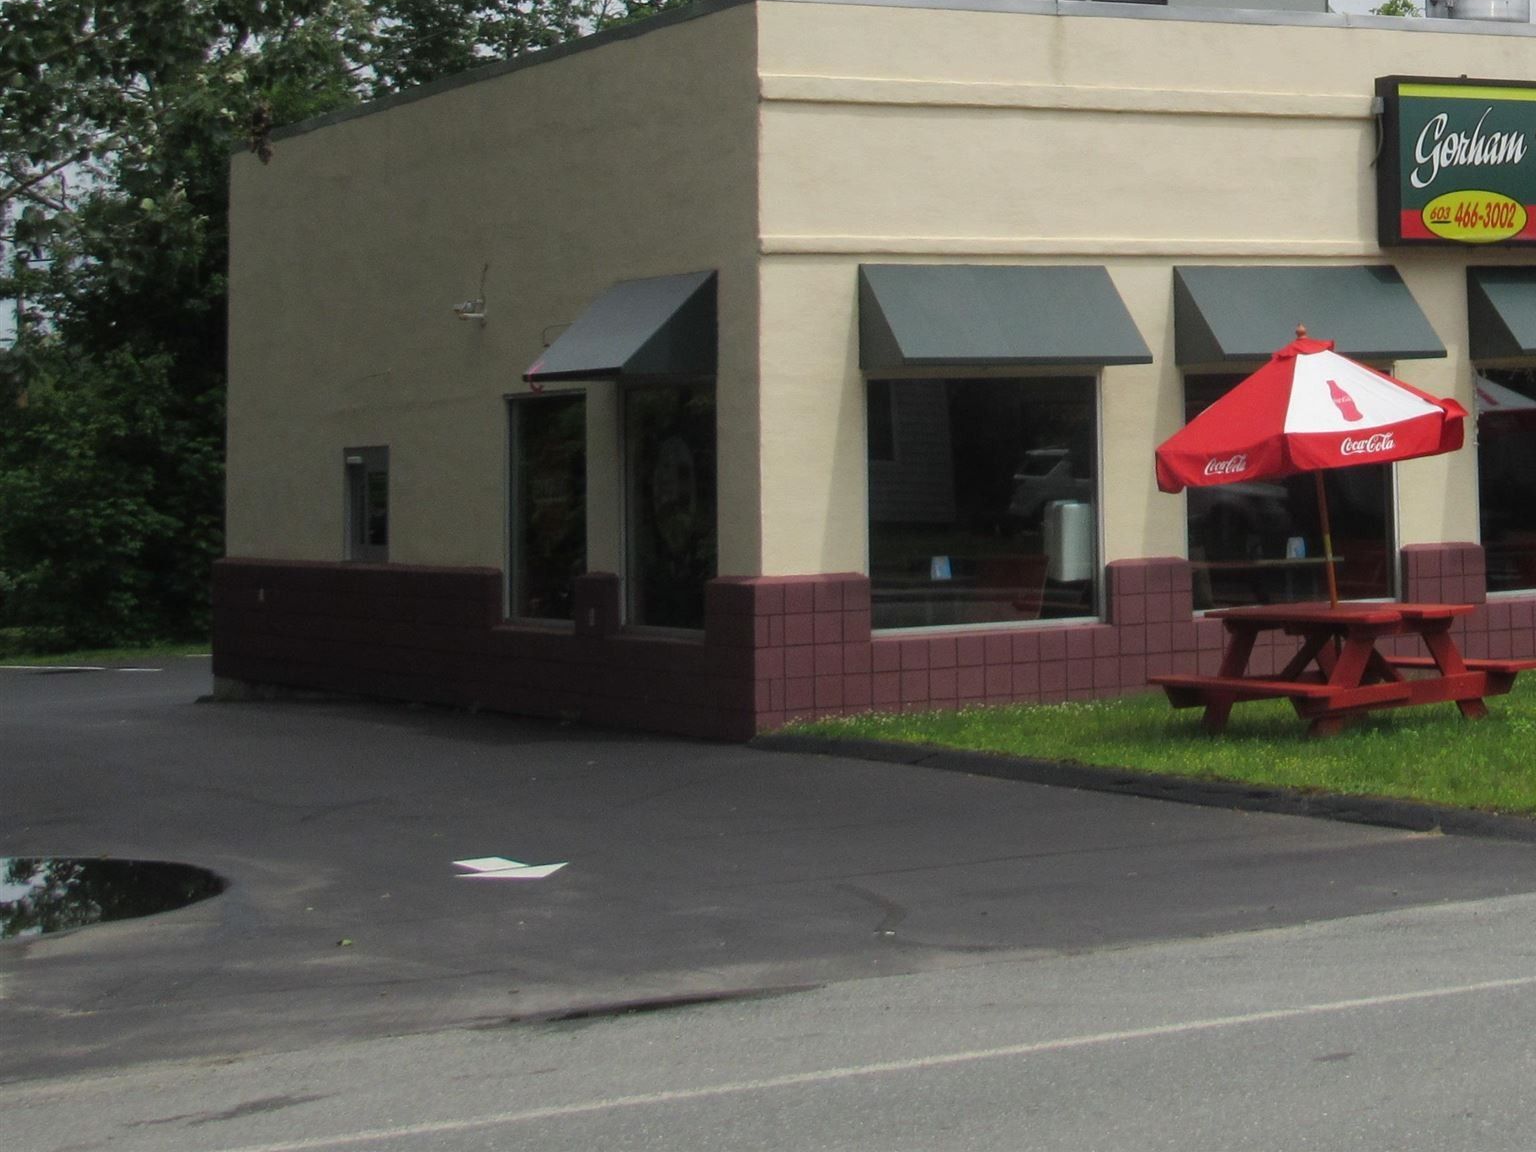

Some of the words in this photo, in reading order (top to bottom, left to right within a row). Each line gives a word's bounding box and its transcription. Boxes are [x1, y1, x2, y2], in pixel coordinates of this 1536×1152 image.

[1410, 106, 1528, 189] Gorham
[1430, 206, 1451, 220] 603
[1454, 201, 1517, 229] 466-3002
